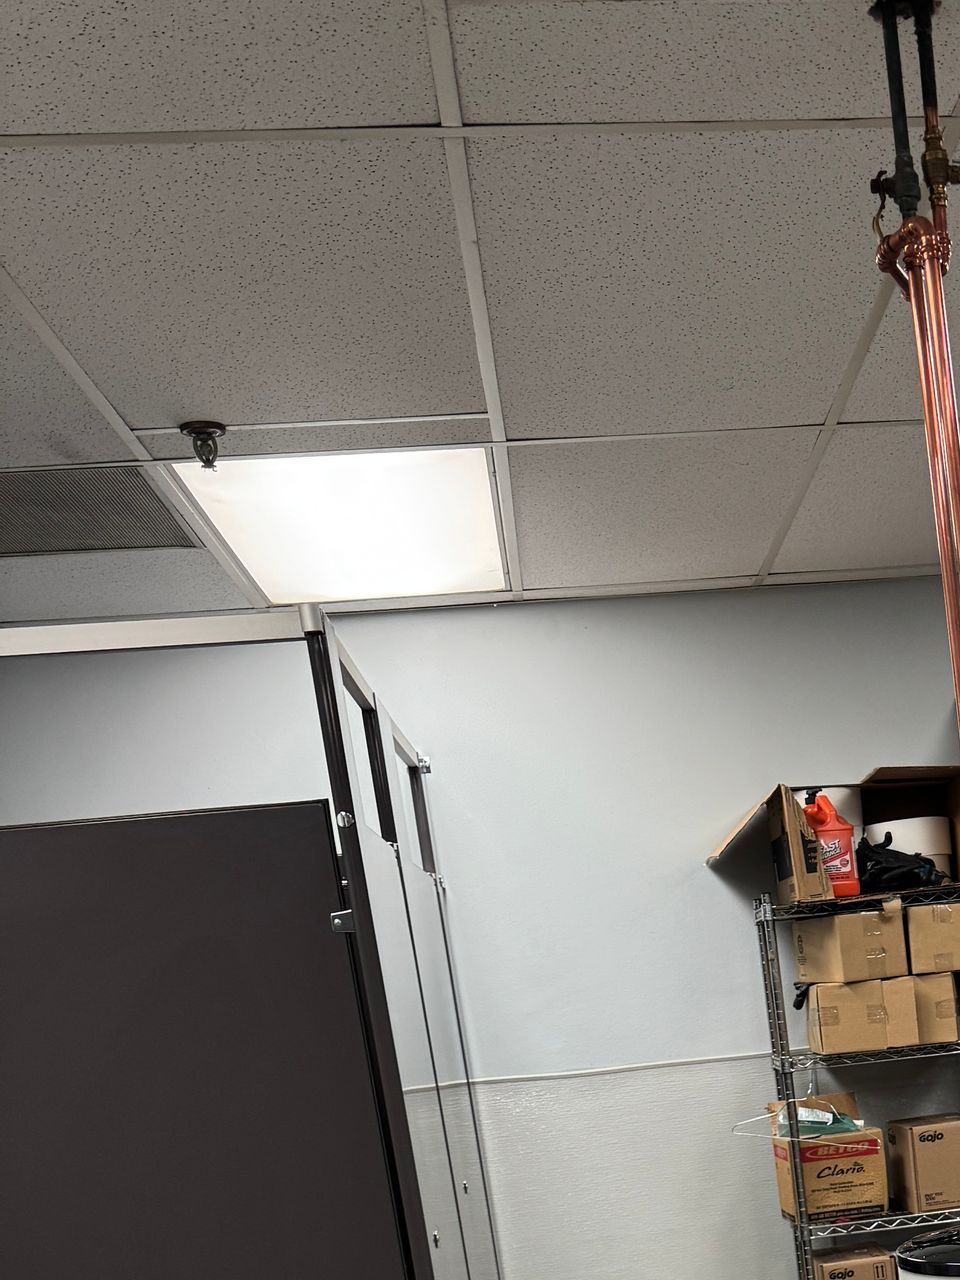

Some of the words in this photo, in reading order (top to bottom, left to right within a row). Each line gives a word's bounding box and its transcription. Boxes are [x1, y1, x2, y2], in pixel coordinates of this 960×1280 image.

[918, 1130, 944, 1143] GOJO
[817, 1141, 870, 1156] BETCO
[829, 1269, 855, 1280] GOJO
